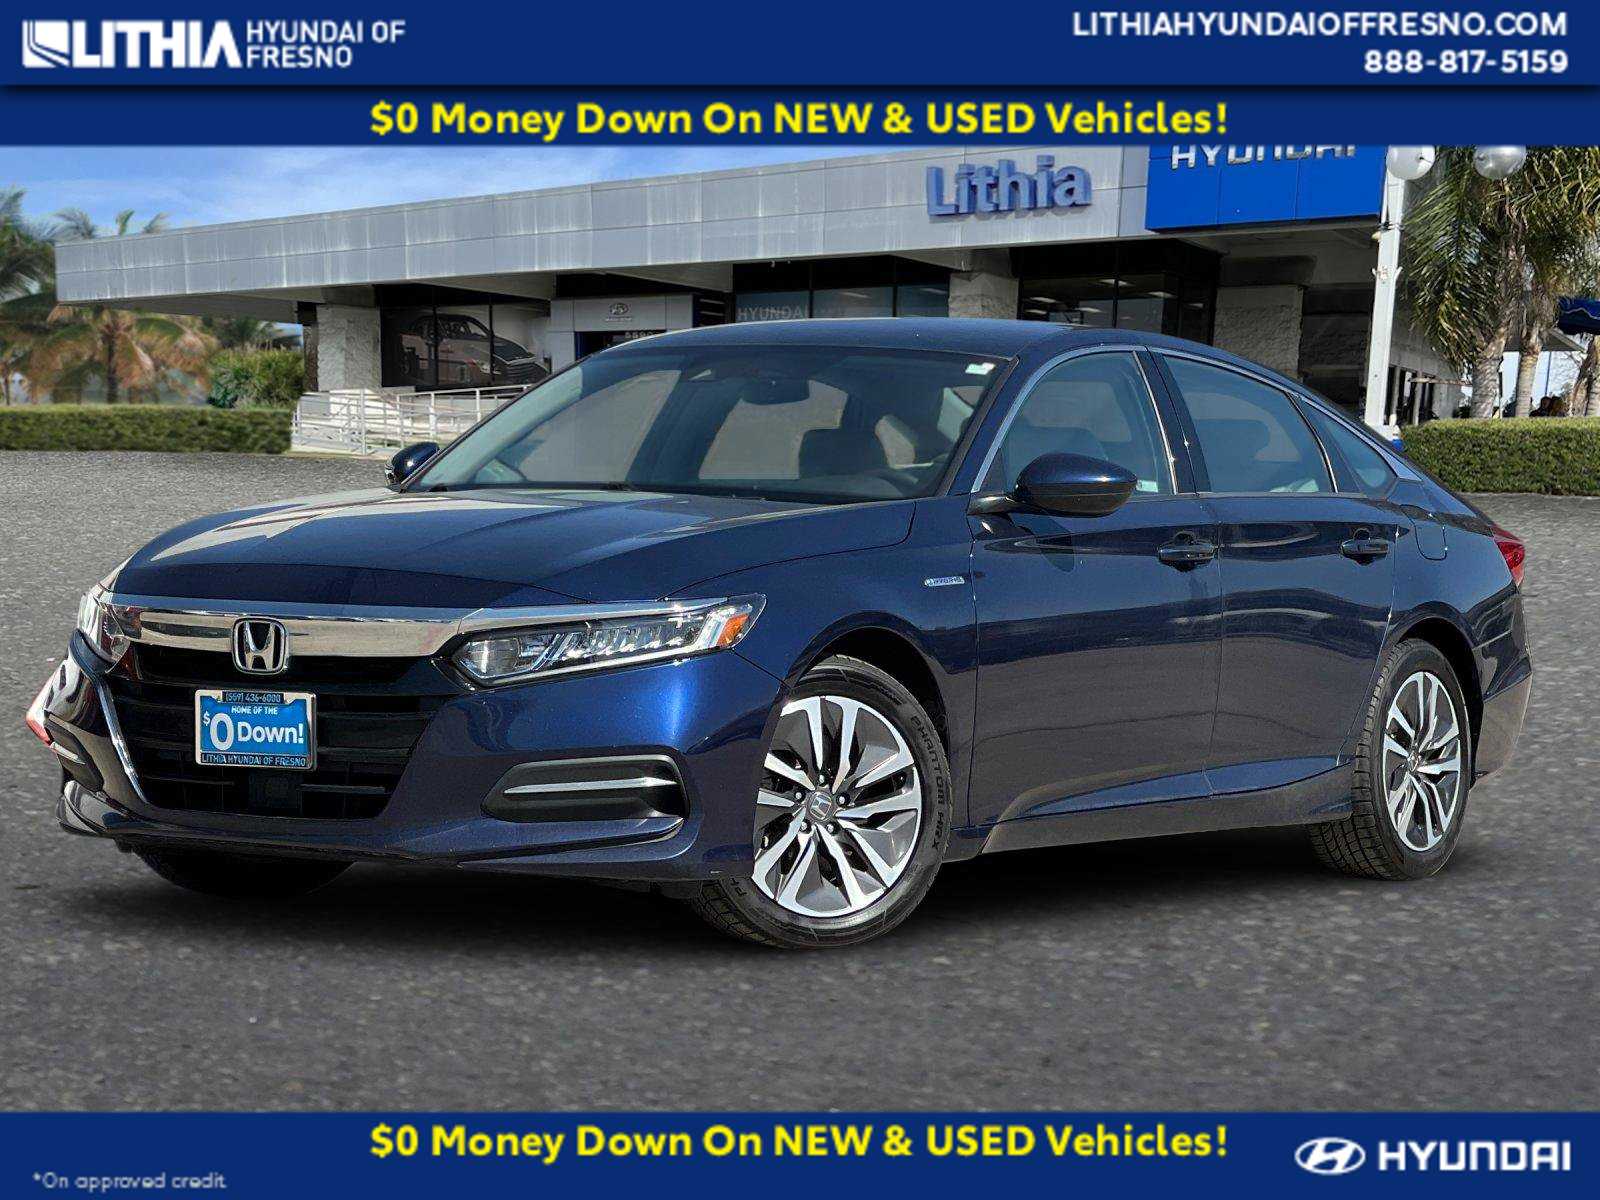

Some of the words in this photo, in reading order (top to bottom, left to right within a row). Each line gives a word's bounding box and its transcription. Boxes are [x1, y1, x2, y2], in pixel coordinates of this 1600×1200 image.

[927, 155, 1092, 216] Lithia
[231, 706, 252, 714] HOME
[253, 706, 261, 715] OF
[264, 706, 278, 715] THE
[237, 721, 304, 744] Down!
[263, 756, 274, 766] OF
[275, 756, 306, 767] FRESNO
